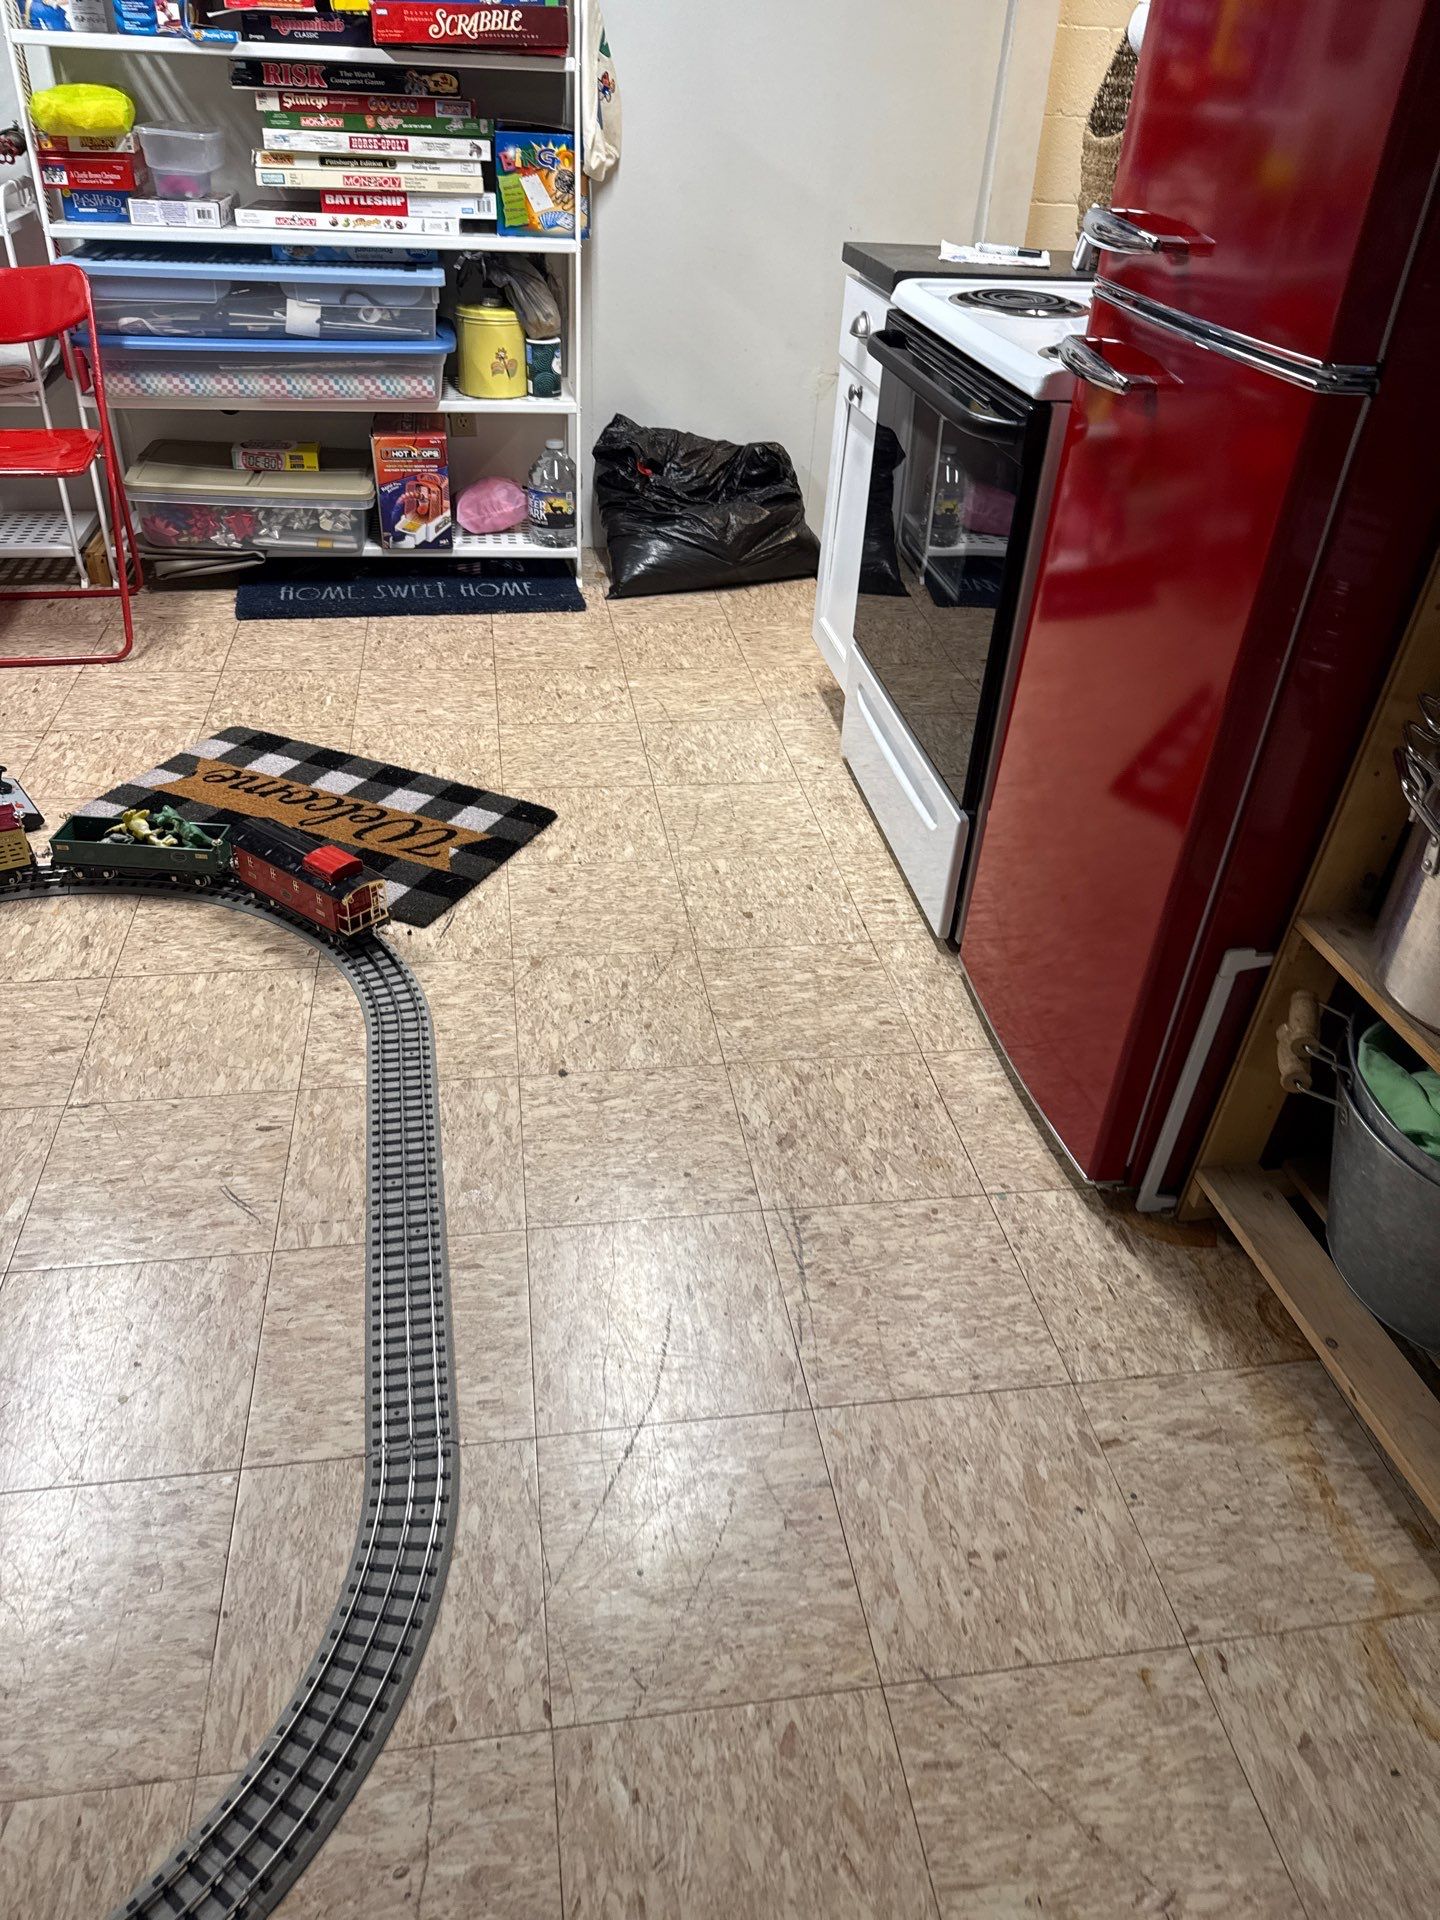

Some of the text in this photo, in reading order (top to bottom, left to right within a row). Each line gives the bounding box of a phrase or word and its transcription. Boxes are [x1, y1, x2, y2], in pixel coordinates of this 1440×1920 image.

[428, 8, 523, 39] SCRABBLE
[293, 31, 320, 39] CLASSIC
[261, 62, 328, 89] RISK
[339, 70, 376, 79] The World
[330, 77, 385, 86] Conquest Game
[282, 93, 329, 110] Stratego
[300, 116, 344, 128] MONOPOLY
[351, 136, 407, 151] HORSE-OPOLY
[360, 158, 384, 168] Edition
[499, 147, 575, 171] BINGO
[343, 175, 401, 188] MONOPOLY
[71, 193, 122, 209] PASSWORD
[324, 194, 405, 207] BATTLESHIP
[275, 216, 317, 227] MONOPOLY
[391, 450, 408, 458] HOT
[528, 499, 545, 510] EER
[528, 508, 548, 521] ARK
[460, 581, 543, 598] HOME.
[202, 768, 458, 858] Welcome
